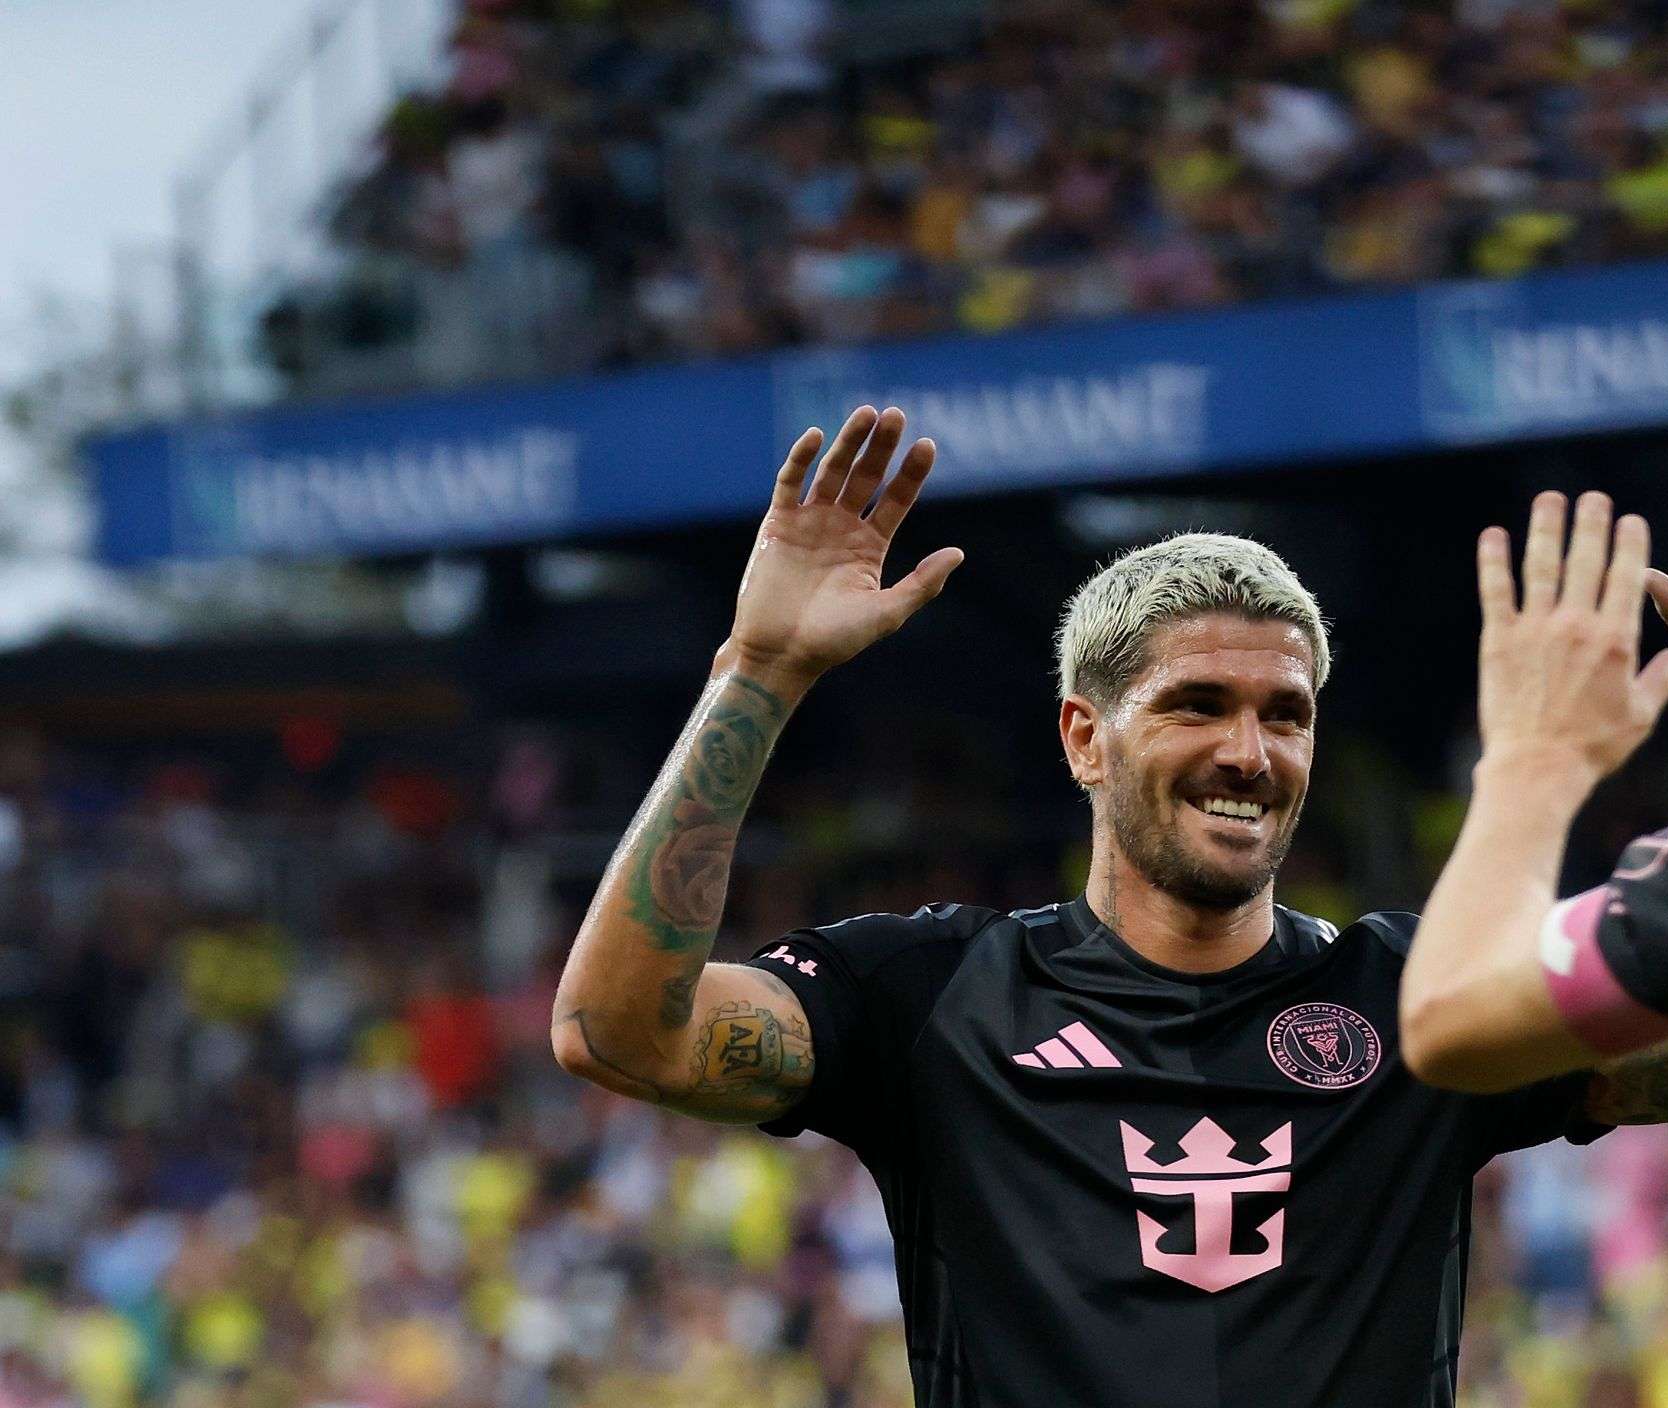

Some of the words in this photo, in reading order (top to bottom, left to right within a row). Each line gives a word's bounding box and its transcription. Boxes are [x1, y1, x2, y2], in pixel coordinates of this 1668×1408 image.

[1272, 1006, 1345, 1047] INTERNACIONAL
[1348, 1015, 1363, 1026] DE
[1296, 1022, 1339, 1035] MIAMI
[1276, 1049, 1299, 1073] CLUB
[1321, 1073, 1356, 1084] MMXX
